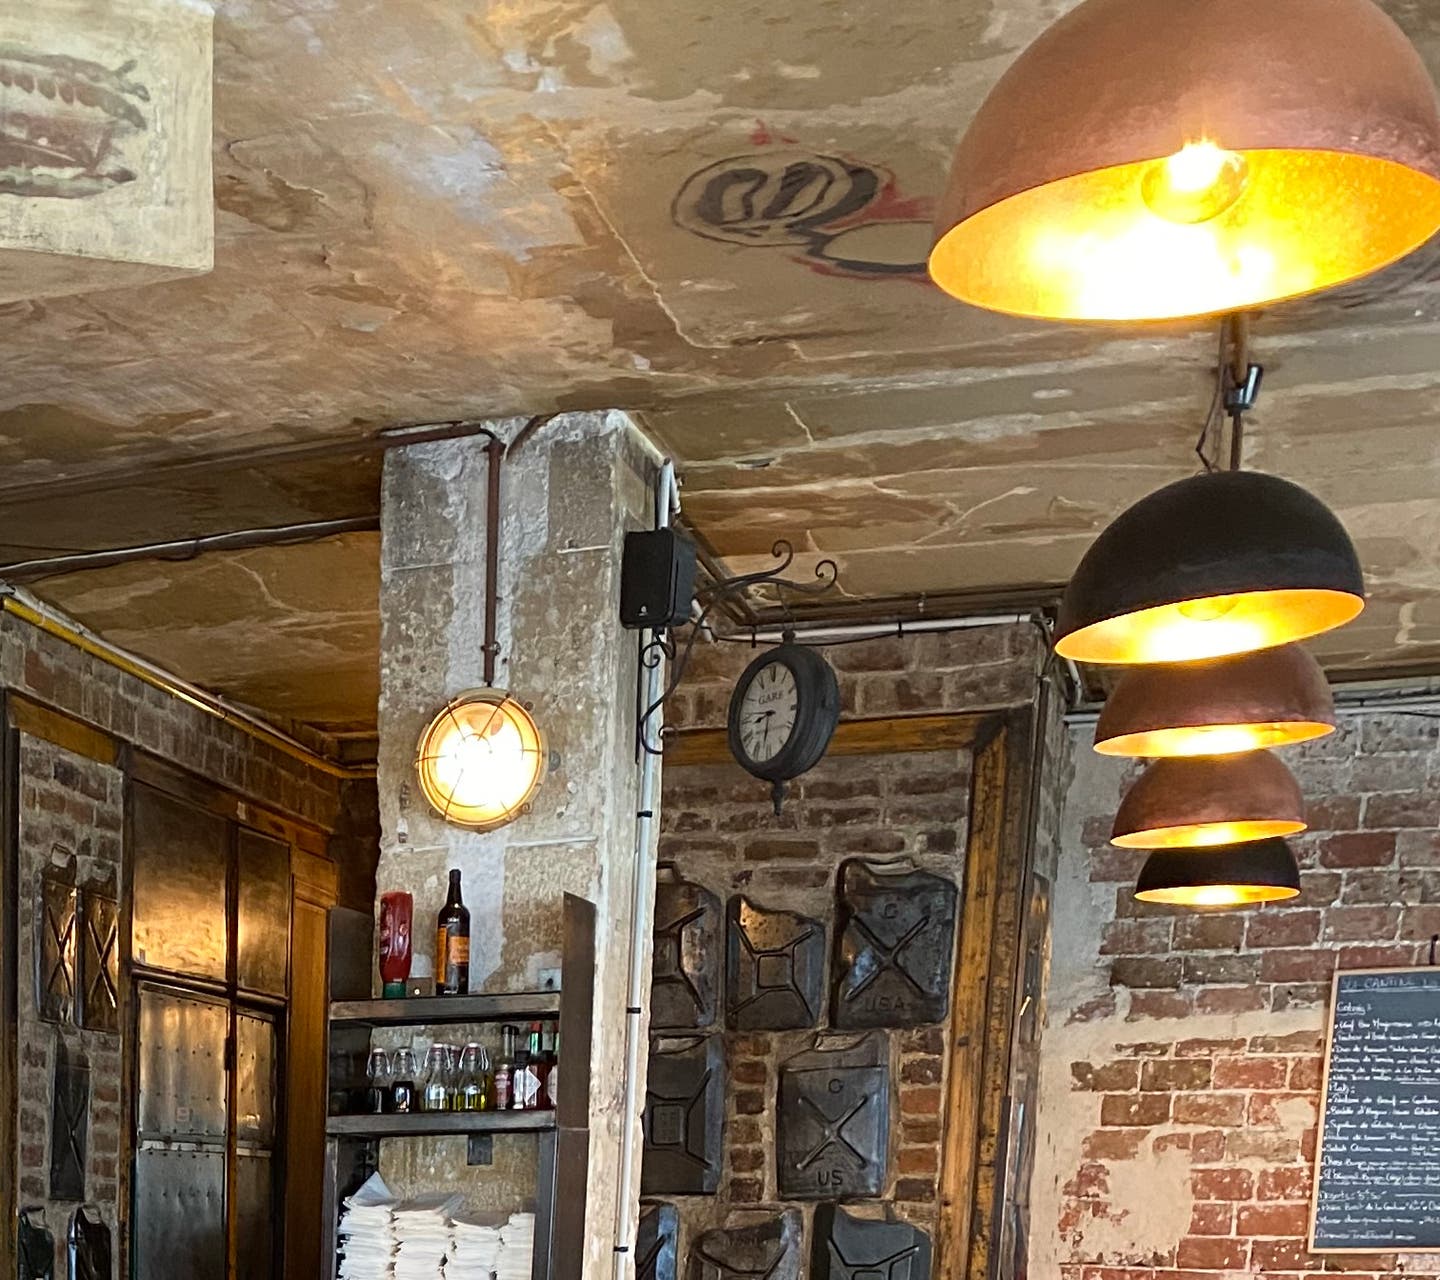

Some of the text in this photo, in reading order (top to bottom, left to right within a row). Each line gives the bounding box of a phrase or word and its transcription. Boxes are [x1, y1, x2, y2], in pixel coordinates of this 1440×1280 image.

[758, 690, 784, 705] GARE
[865, 996, 904, 1012] USA
[817, 1169, 843, 1186] US
